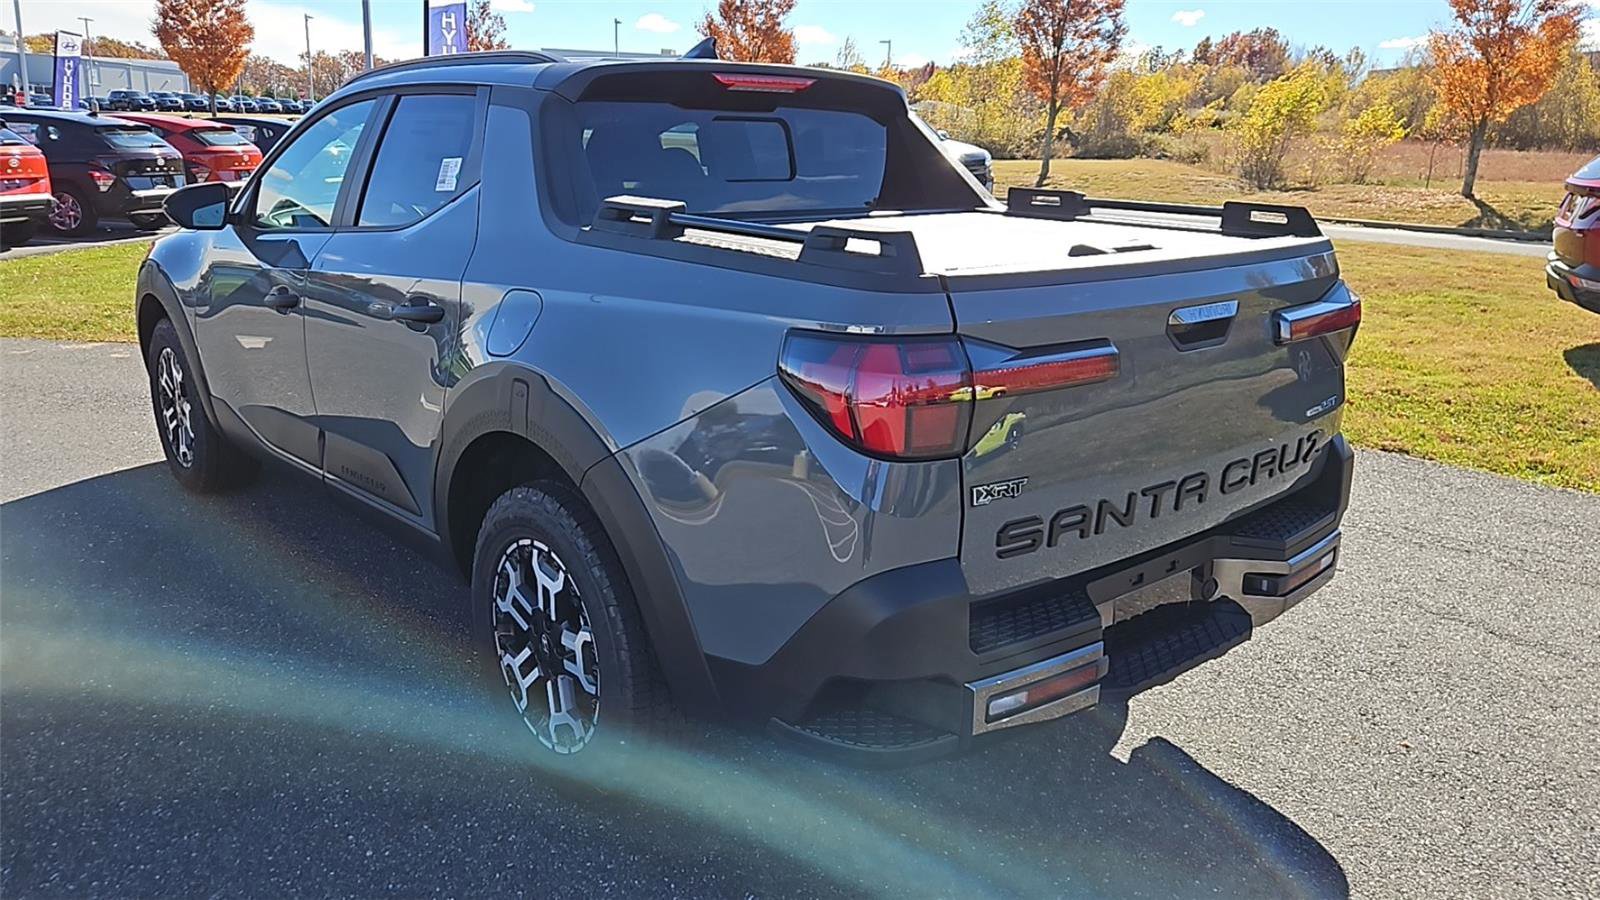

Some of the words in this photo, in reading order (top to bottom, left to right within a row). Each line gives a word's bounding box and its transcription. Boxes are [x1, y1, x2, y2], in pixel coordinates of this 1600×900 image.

[971, 476, 1029, 507] XRT
[995, 471, 1211, 559] SANTA
[1220, 428, 1327, 495] CRUZ
